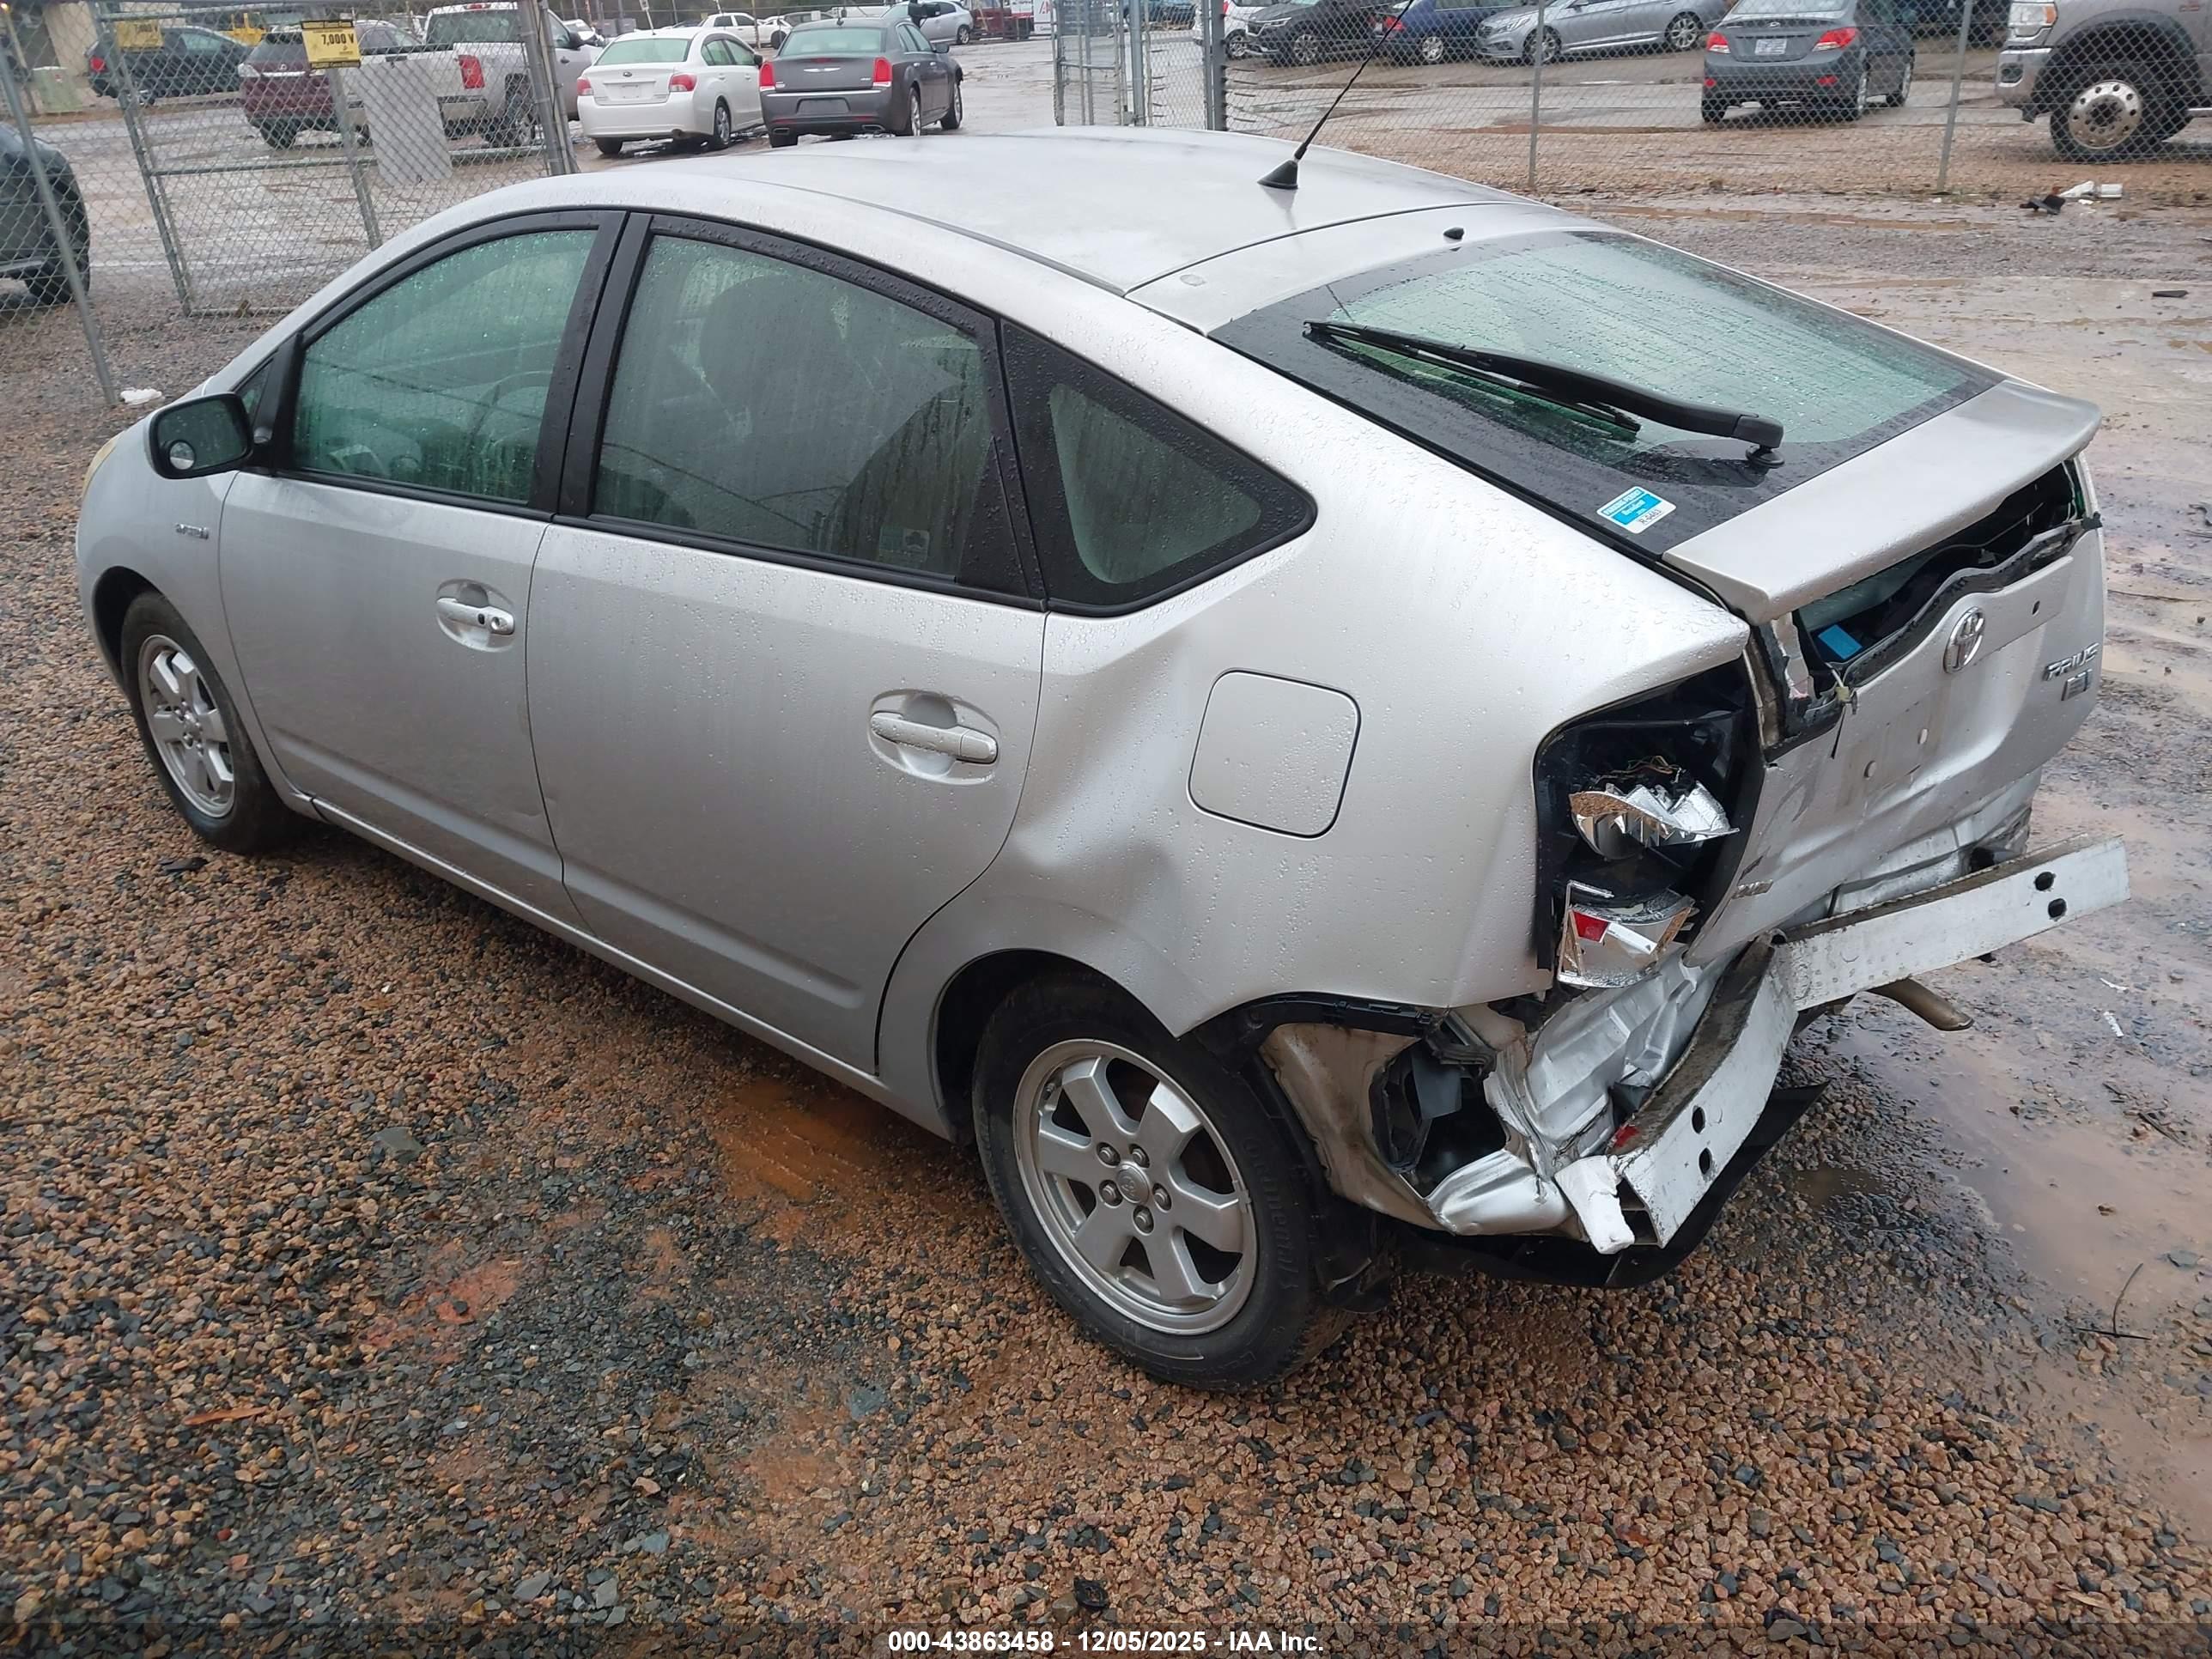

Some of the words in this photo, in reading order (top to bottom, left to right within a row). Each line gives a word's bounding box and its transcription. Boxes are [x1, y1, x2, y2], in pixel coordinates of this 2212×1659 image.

[320, 33, 347, 46] 7,000
[348, 33, 355, 44] V
[2042, 642, 2100, 681] PRIUS
